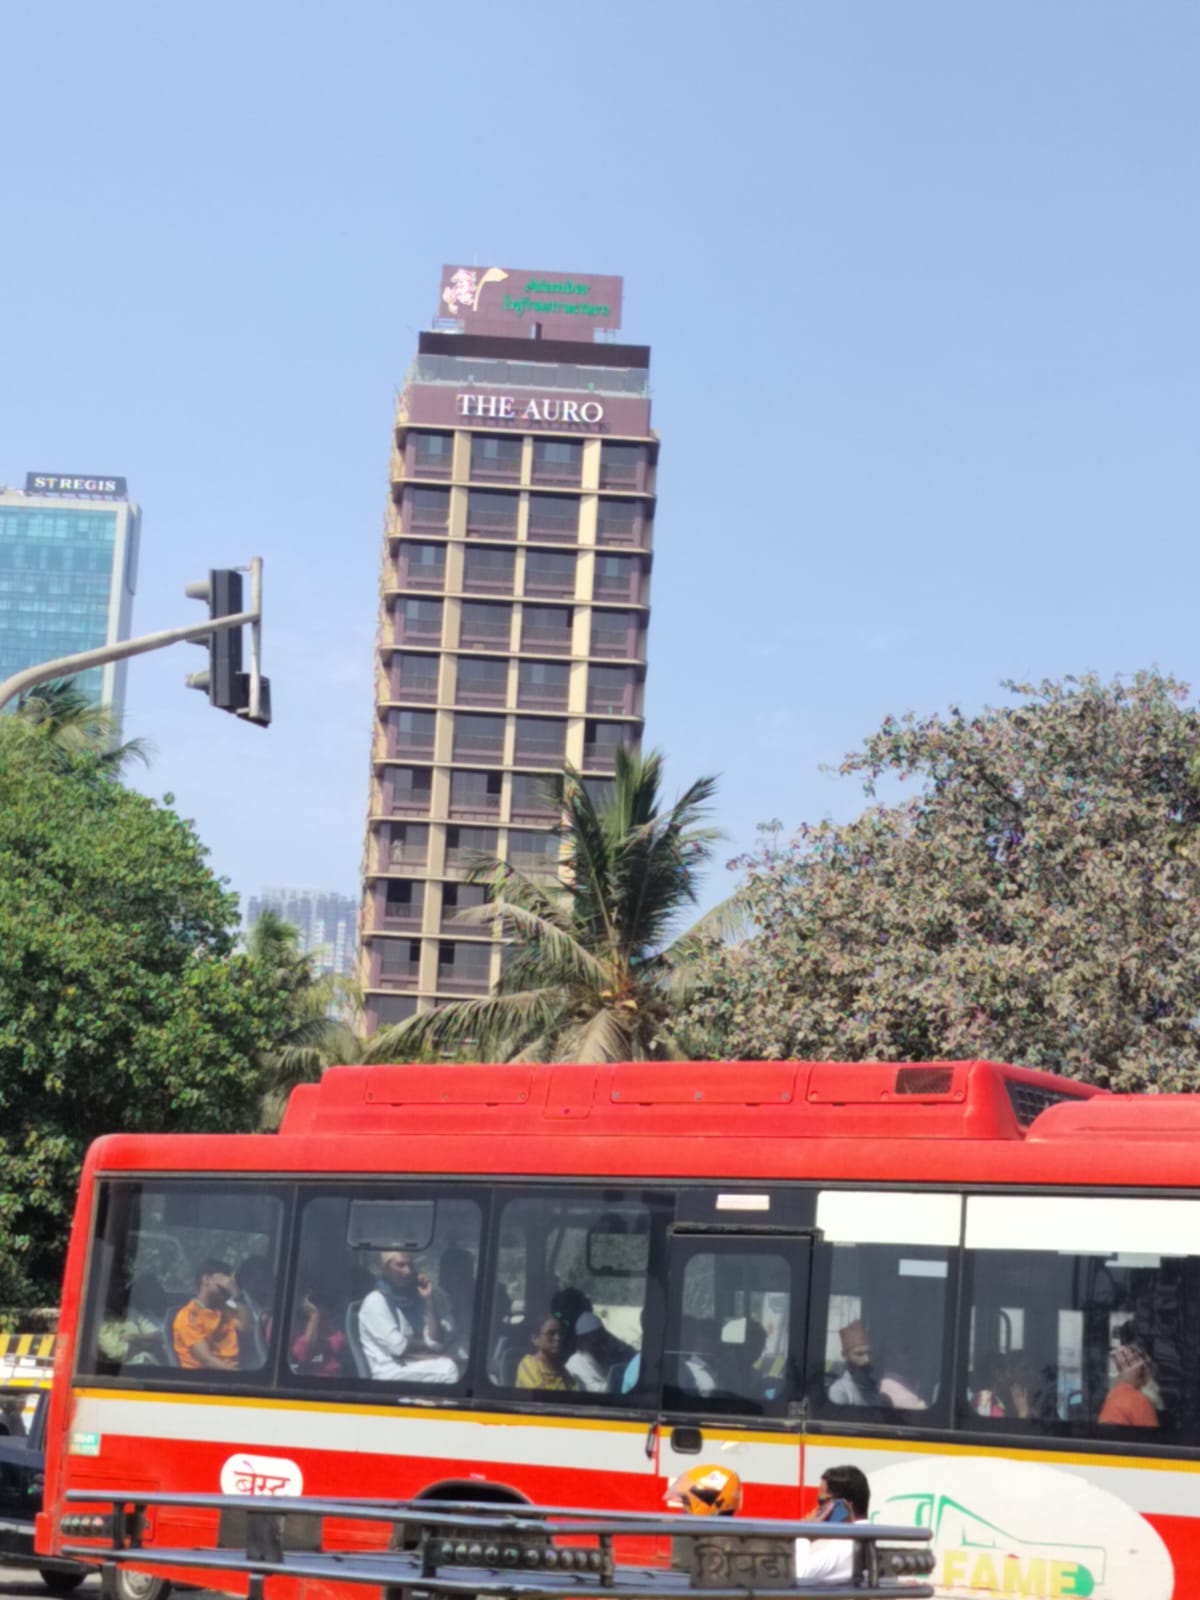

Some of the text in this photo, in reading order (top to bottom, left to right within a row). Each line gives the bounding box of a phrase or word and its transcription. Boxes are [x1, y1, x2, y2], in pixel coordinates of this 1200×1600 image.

[457, 394, 604, 423] THE AURO
[59, 478, 117, 492] REGIS
[942, 1550, 1078, 1599] FAME
